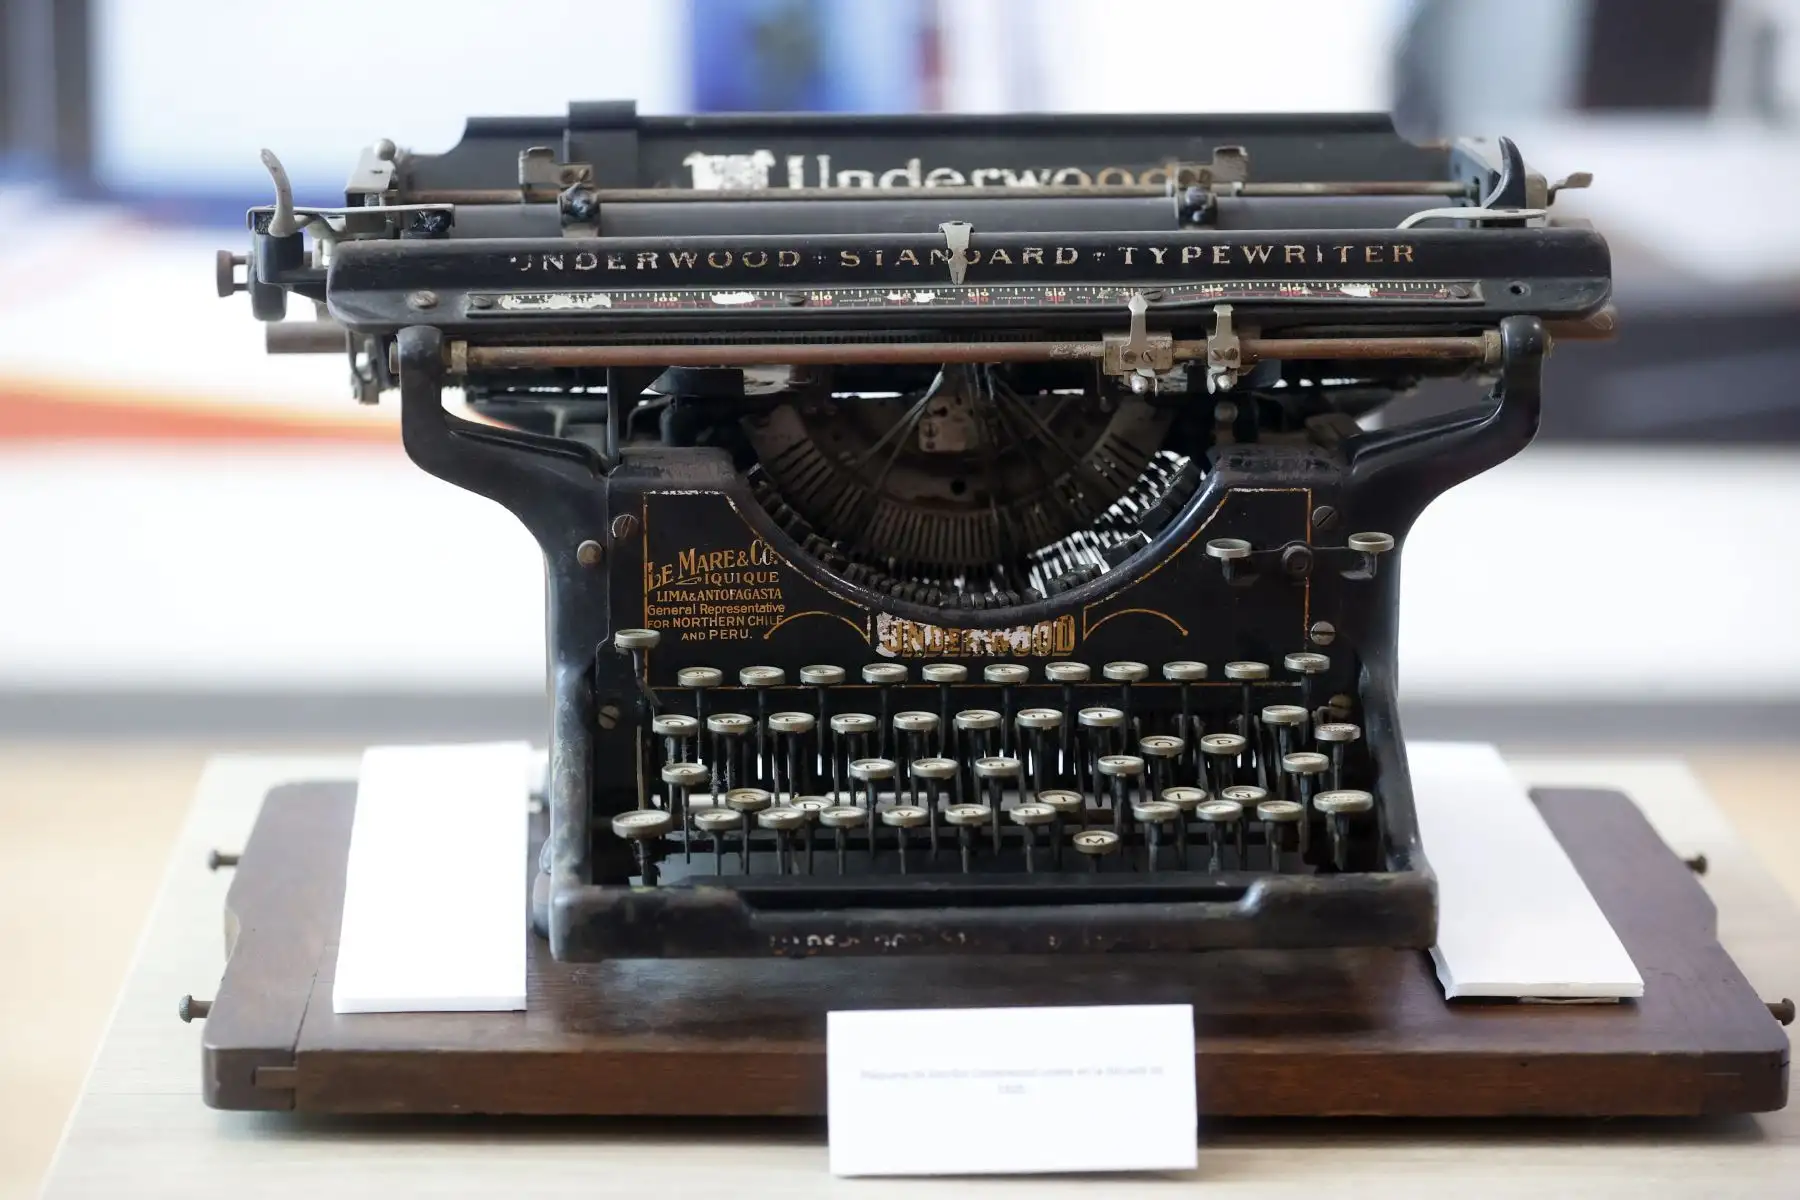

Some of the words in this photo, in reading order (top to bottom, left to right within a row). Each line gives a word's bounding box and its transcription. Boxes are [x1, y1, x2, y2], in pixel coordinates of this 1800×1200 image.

[1118, 243, 1416, 266] TYPEWRITER
[704, 571, 779, 586] IQUIQUE
[647, 604, 696, 616] General
[700, 603, 785, 616] Representative
[647, 620, 670, 628] FOR
[673, 616, 745, 628] NORTHERN
[747, 615, 784, 627] CHILE
[681, 632, 706, 641] AND
[709, 629, 753, 640] PERU.
